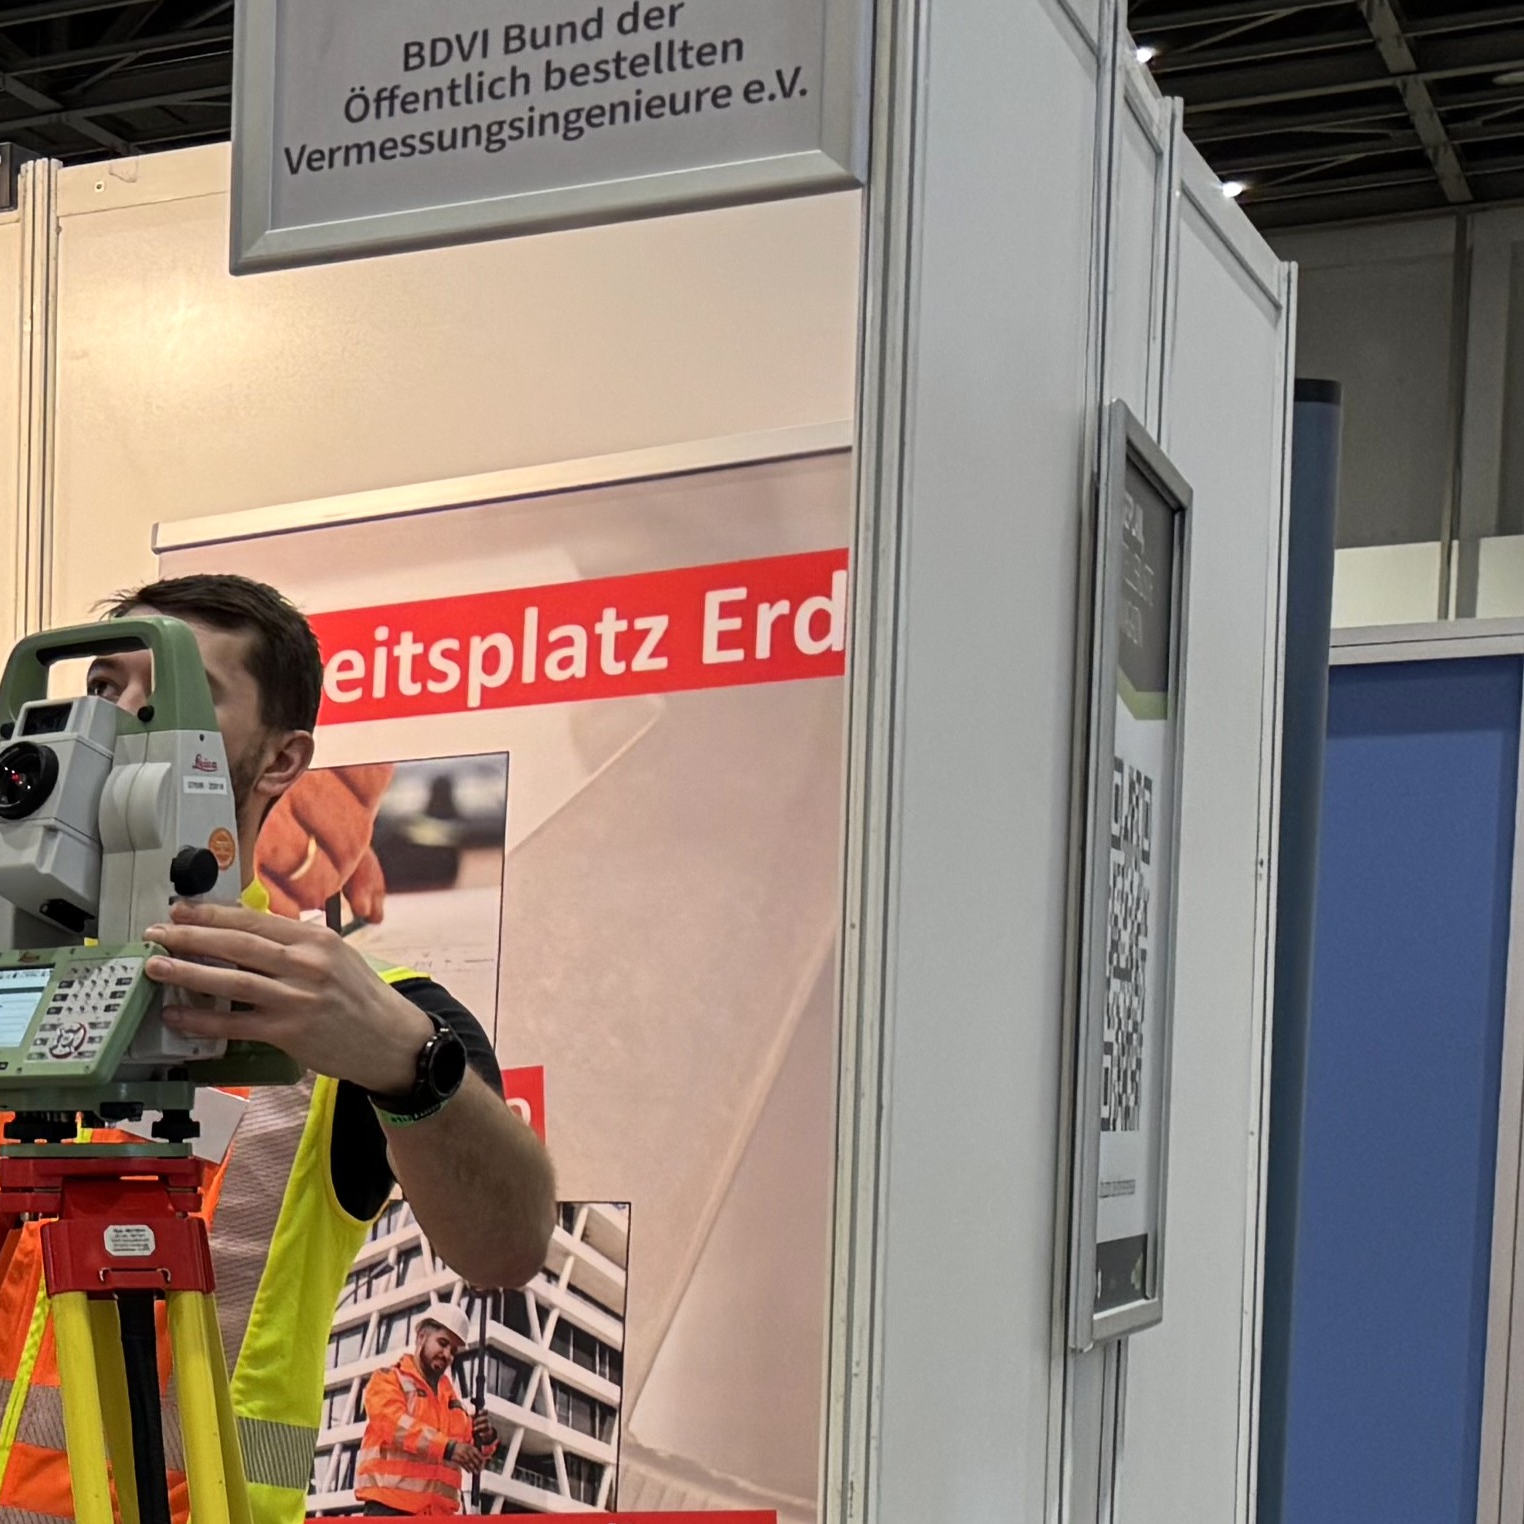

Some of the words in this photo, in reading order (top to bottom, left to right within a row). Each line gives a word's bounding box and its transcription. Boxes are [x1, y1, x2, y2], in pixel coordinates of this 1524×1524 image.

[402, 29, 489, 72] BDVI
[502, 7, 604, 56] Bund
[616, 0, 686, 35] der
[283, 80, 733, 176] Vermessungsingenieure
[742, 66, 809, 104] e.V.
[343, 65, 531, 124] Öffentlich
[544, 37, 745, 91] bestellten
